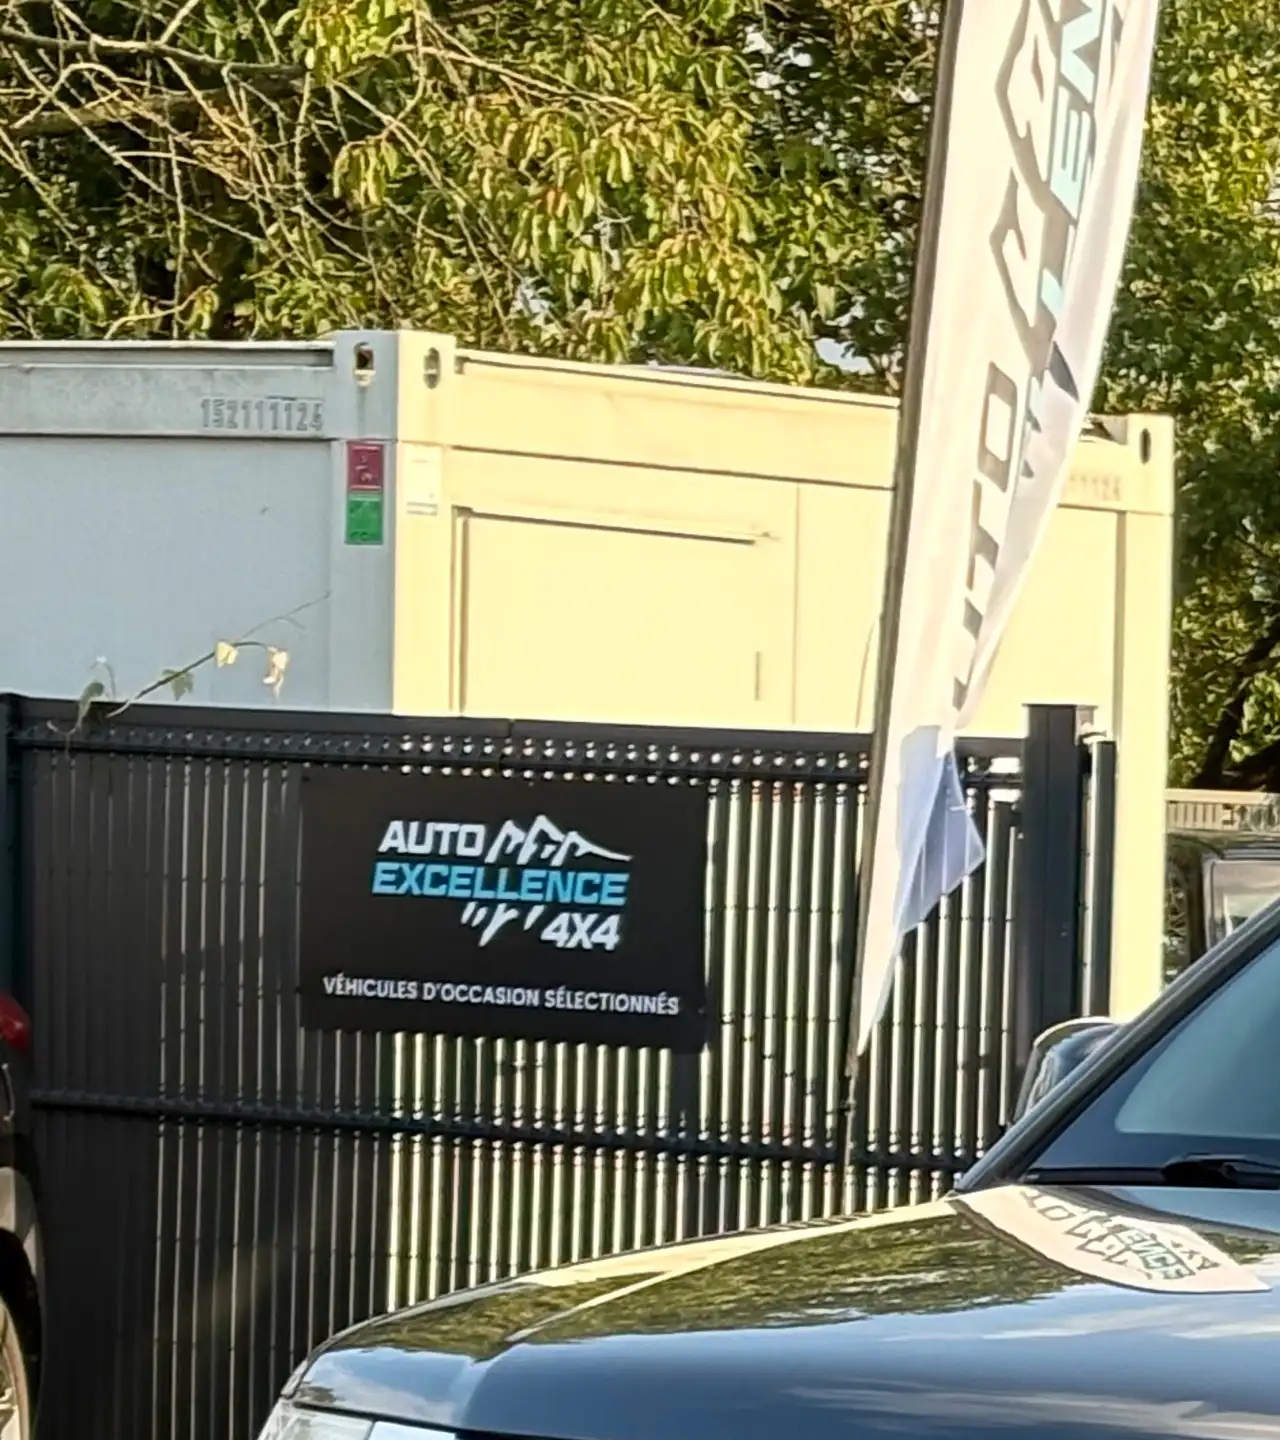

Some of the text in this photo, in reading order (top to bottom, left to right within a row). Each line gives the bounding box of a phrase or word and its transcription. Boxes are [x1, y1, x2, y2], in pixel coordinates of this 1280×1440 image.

[378, 820, 488, 858] AUTO
[372, 861, 630, 906] EXCELLENCE
[541, 912, 620, 951] 4X4
[323, 972, 680, 1016] VÉHICULES D'OCCASION SÉLECTIONNÉS
